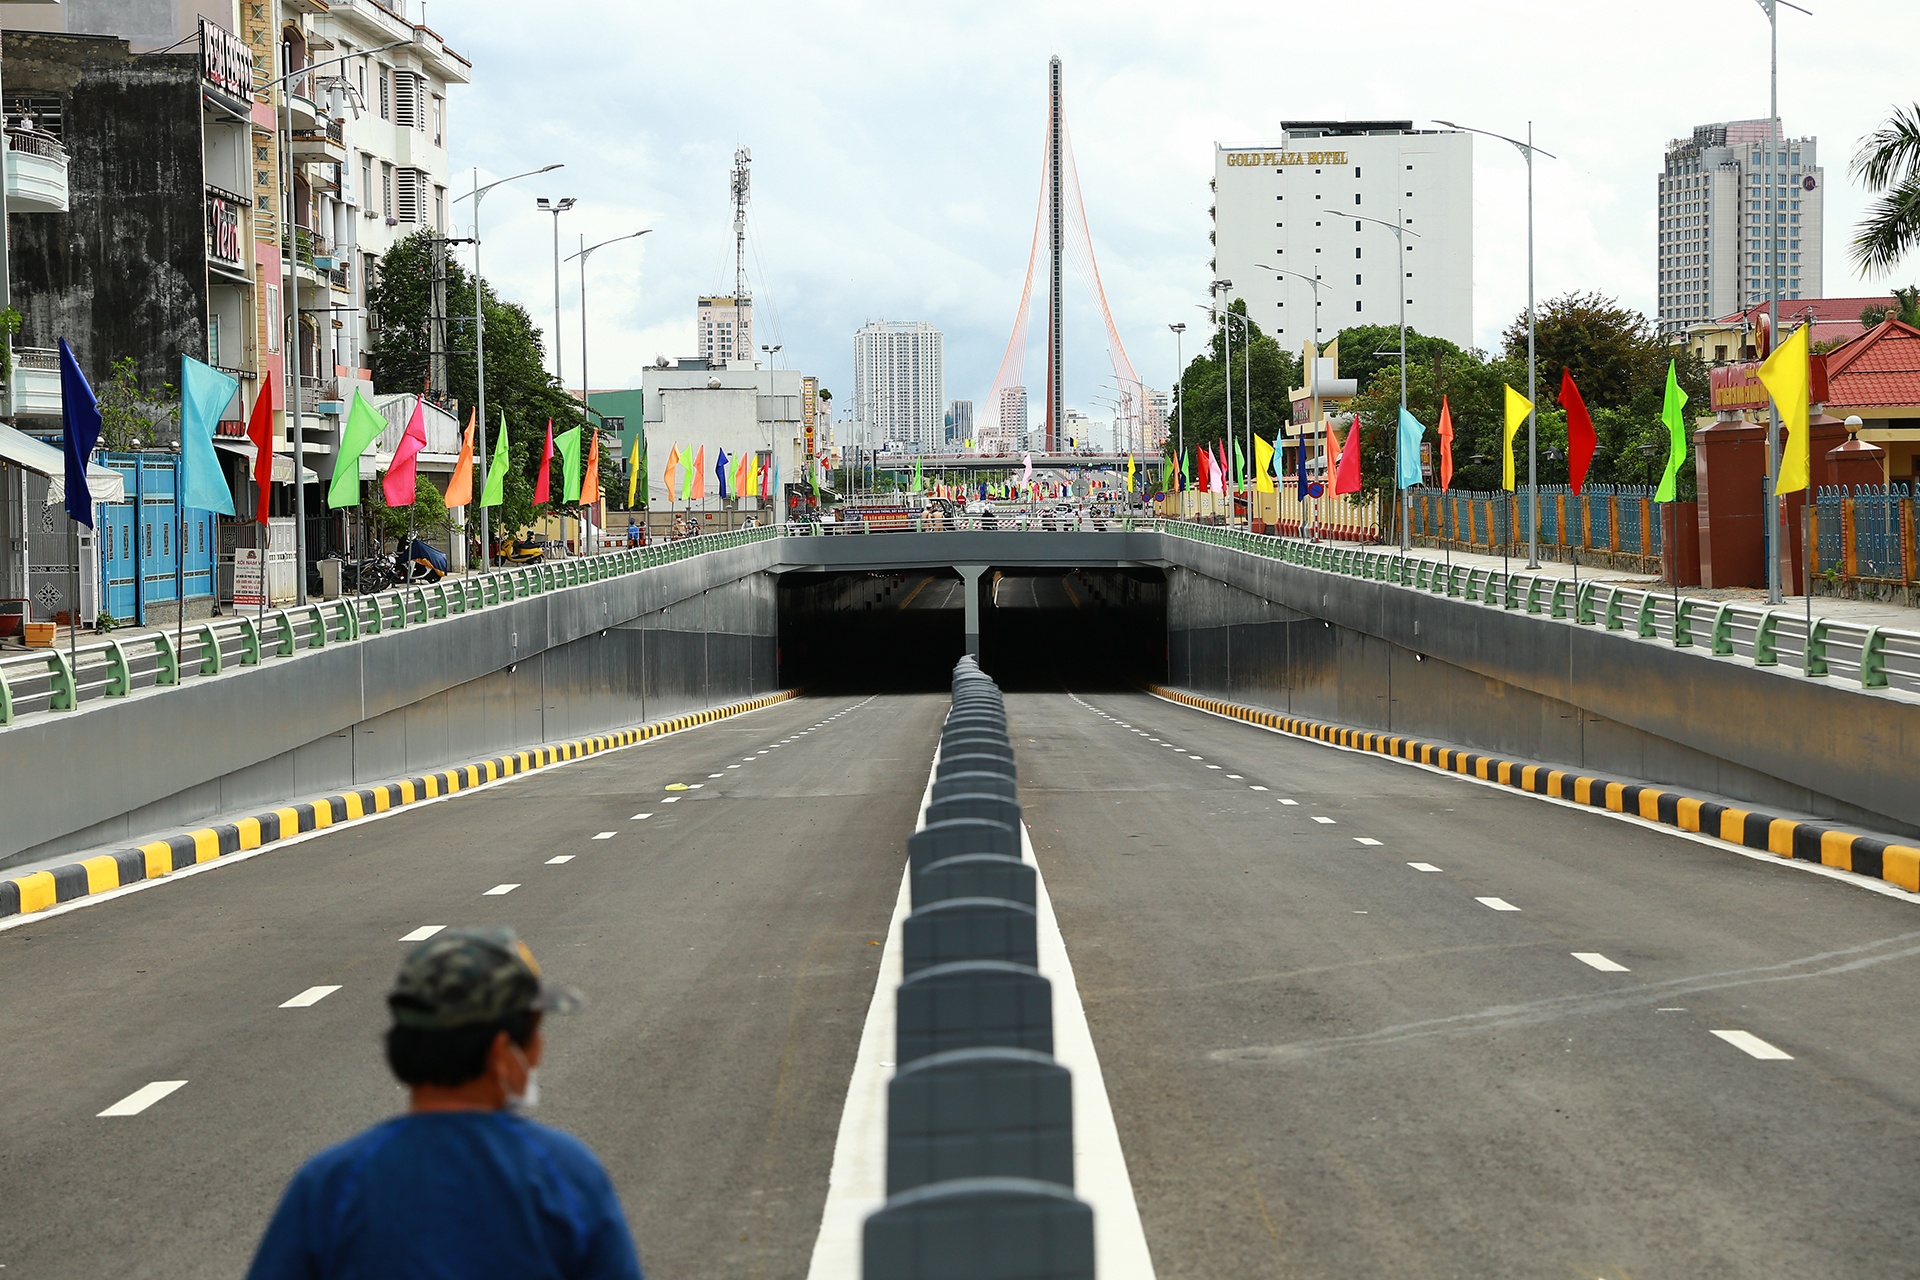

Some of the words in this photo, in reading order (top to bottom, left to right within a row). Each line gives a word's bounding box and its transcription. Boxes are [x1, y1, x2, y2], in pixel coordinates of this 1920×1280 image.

[226, 34, 254, 103] COFFEE
[1227, 153, 1260, 166] GOLD
[1263, 152, 1304, 165] PLAZA
[1307, 151, 1348, 165] HOTEL
